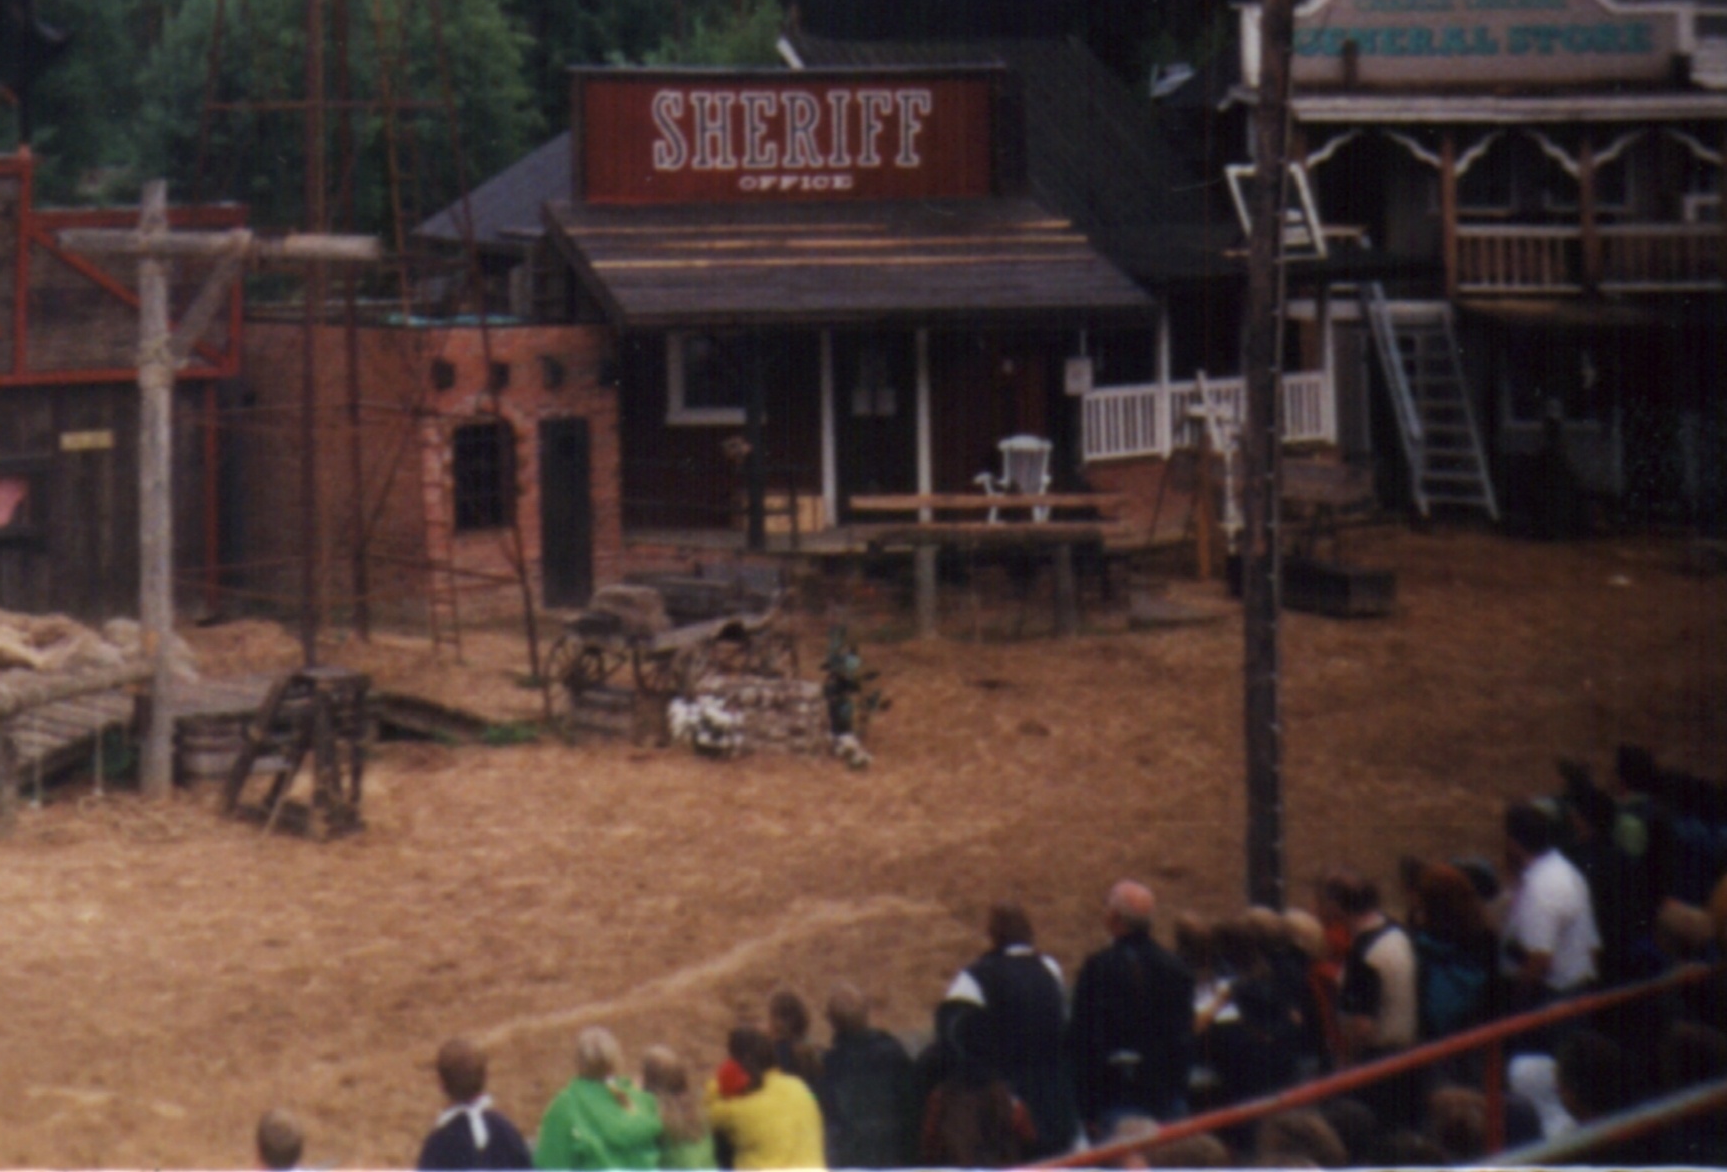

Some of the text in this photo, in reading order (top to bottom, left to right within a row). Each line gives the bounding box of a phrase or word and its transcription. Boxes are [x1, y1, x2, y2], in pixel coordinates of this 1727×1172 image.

[1508, 22, 1654, 54] STORE
[652, 89, 933, 171] SHERIFF
[738, 173, 855, 191] OFFICE
